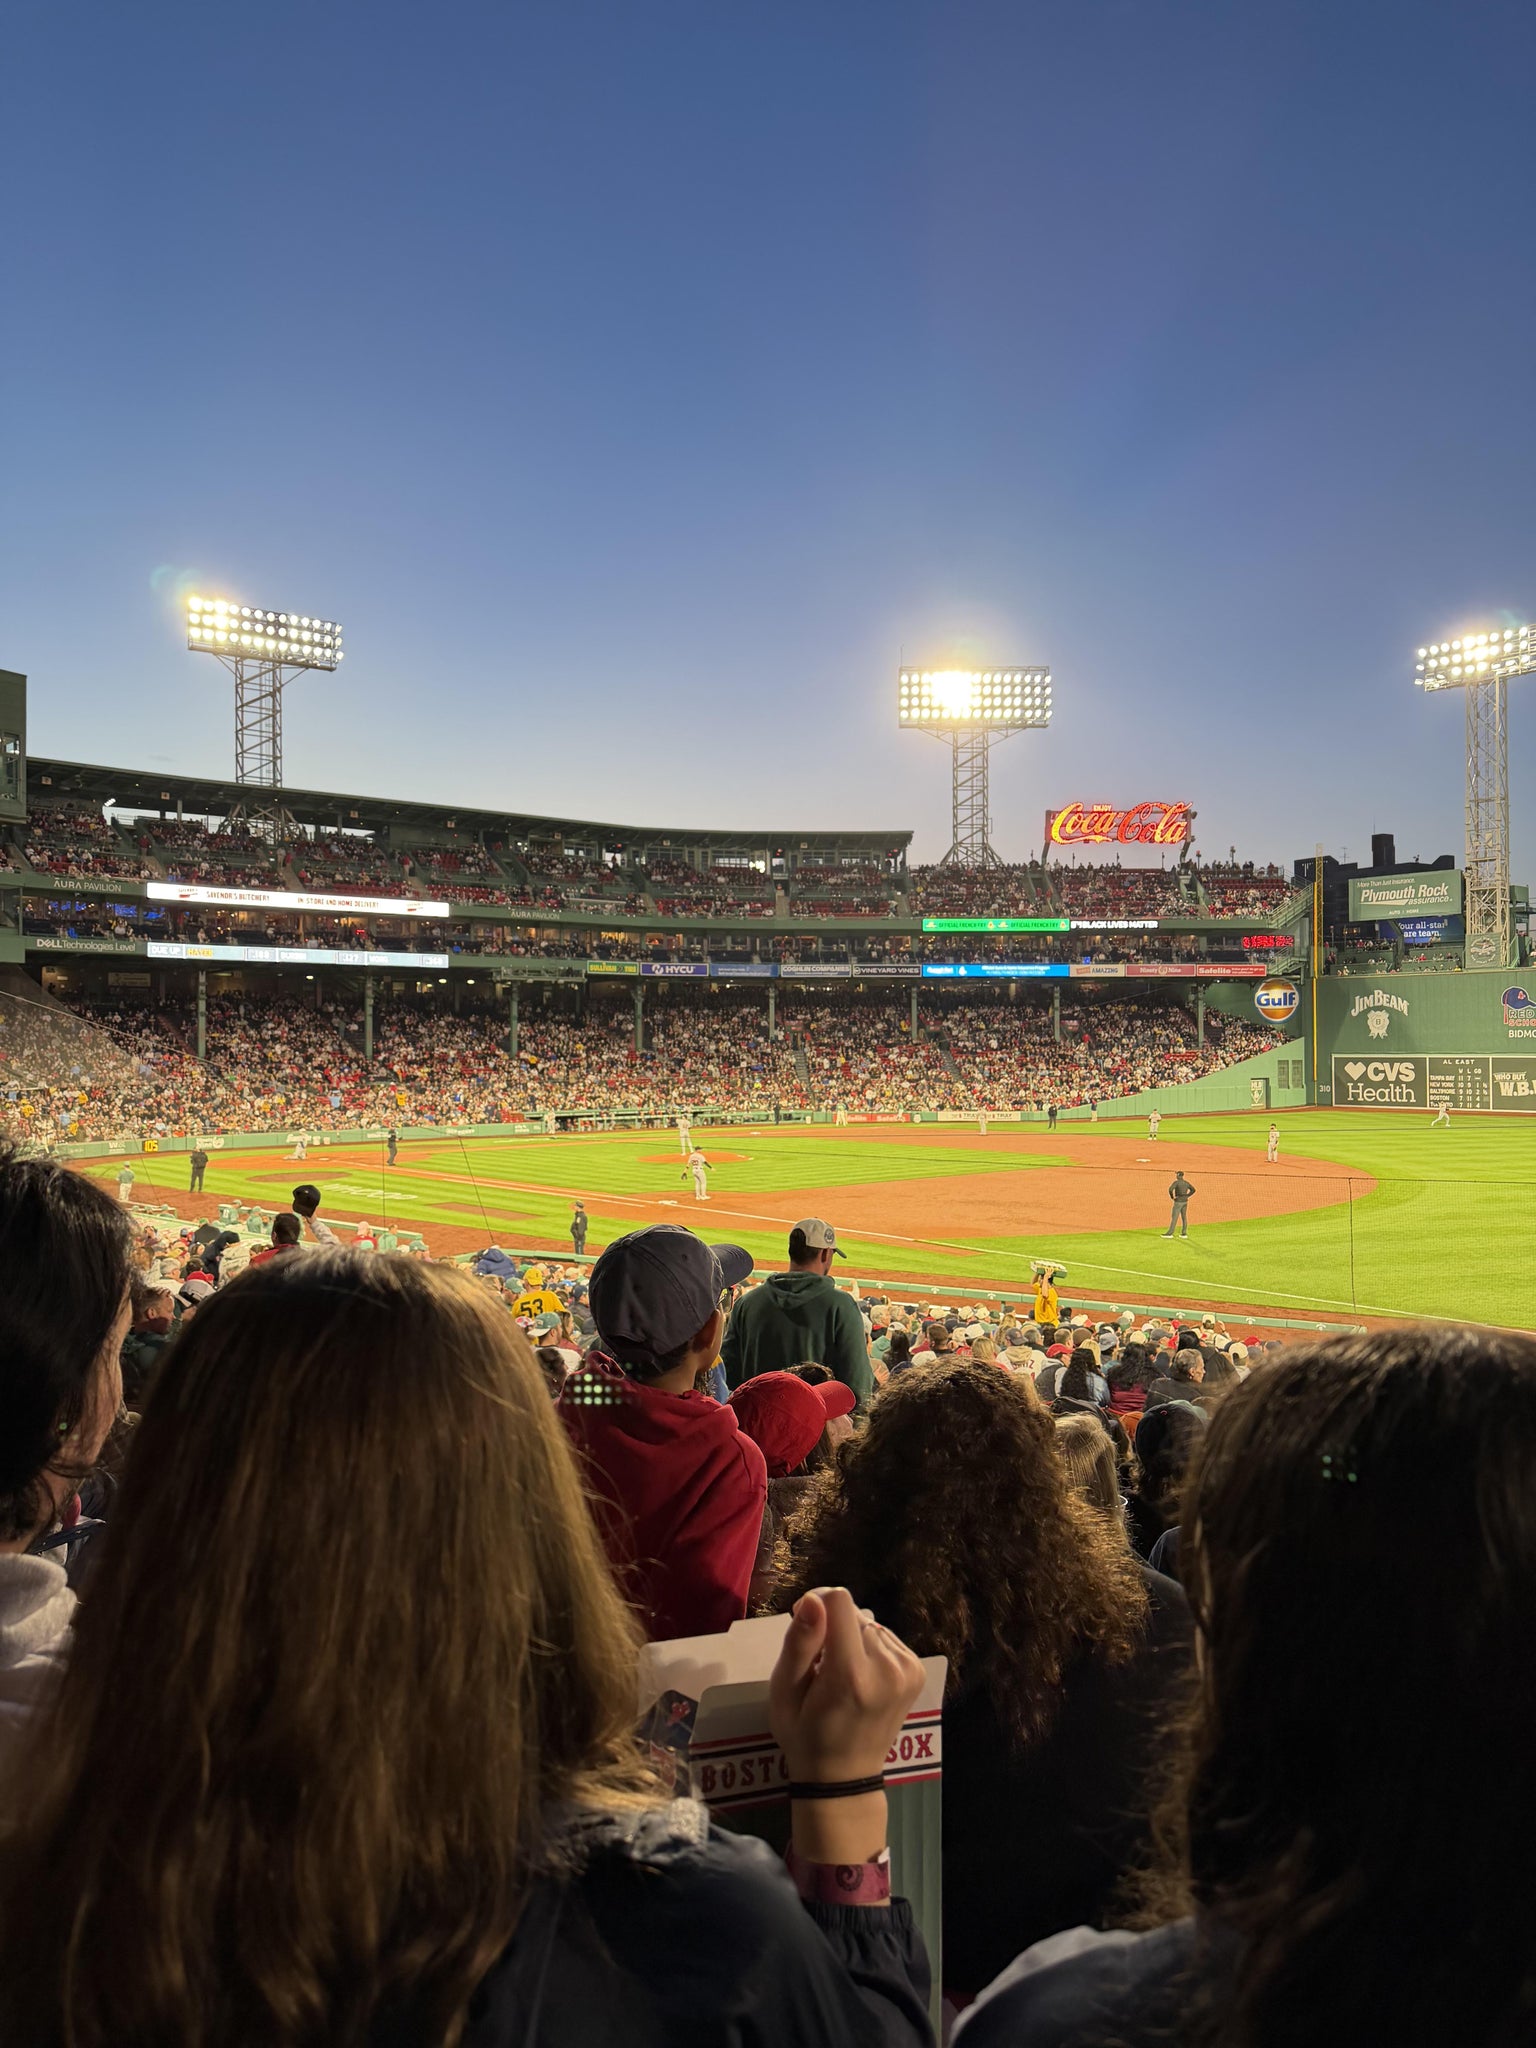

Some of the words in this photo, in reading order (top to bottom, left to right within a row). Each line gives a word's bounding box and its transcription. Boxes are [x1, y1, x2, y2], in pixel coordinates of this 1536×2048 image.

[1093, 804, 1112, 812] ENJOY
[1051, 802, 1193, 845] Coca-Cola
[83, 881, 122, 892] PAVILION
[1361, 885, 1415, 902] Plymouth
[1418, 883, 1449, 897] Rock
[338, 899, 353, 907] HOME
[532, 911, 560, 920] PAVILION
[1083, 920, 1106, 929] BLACK
[1107, 920, 1128, 929] LIVES
[1129, 920, 1158, 929] MATTER
[1398, 922, 1413, 930] our
[36, 938, 62, 948] DELL
[63, 940, 114, 952] Technologies
[115, 942, 135, 951] Level
[168, 946, 180, 955] UP
[665, 965, 694, 974] HYCU
[1140, 967, 1158, 975] Ninety
[1256, 992, 1295, 1006] Gulf
[1351, 995, 1374, 1017] JIM
[1374, 989, 1409, 1016] BEAM
[1508, 1009, 1535, 1018] RED
[1367, 1061, 1416, 1082] CVS
[1494, 1072, 1511, 1080] WHO
[1512, 1072, 1526, 1080] BUT
[1347, 1082, 1417, 1103] Health
[144, 1139, 158, 1153] 105
[519, 1298, 544, 1319] 53
